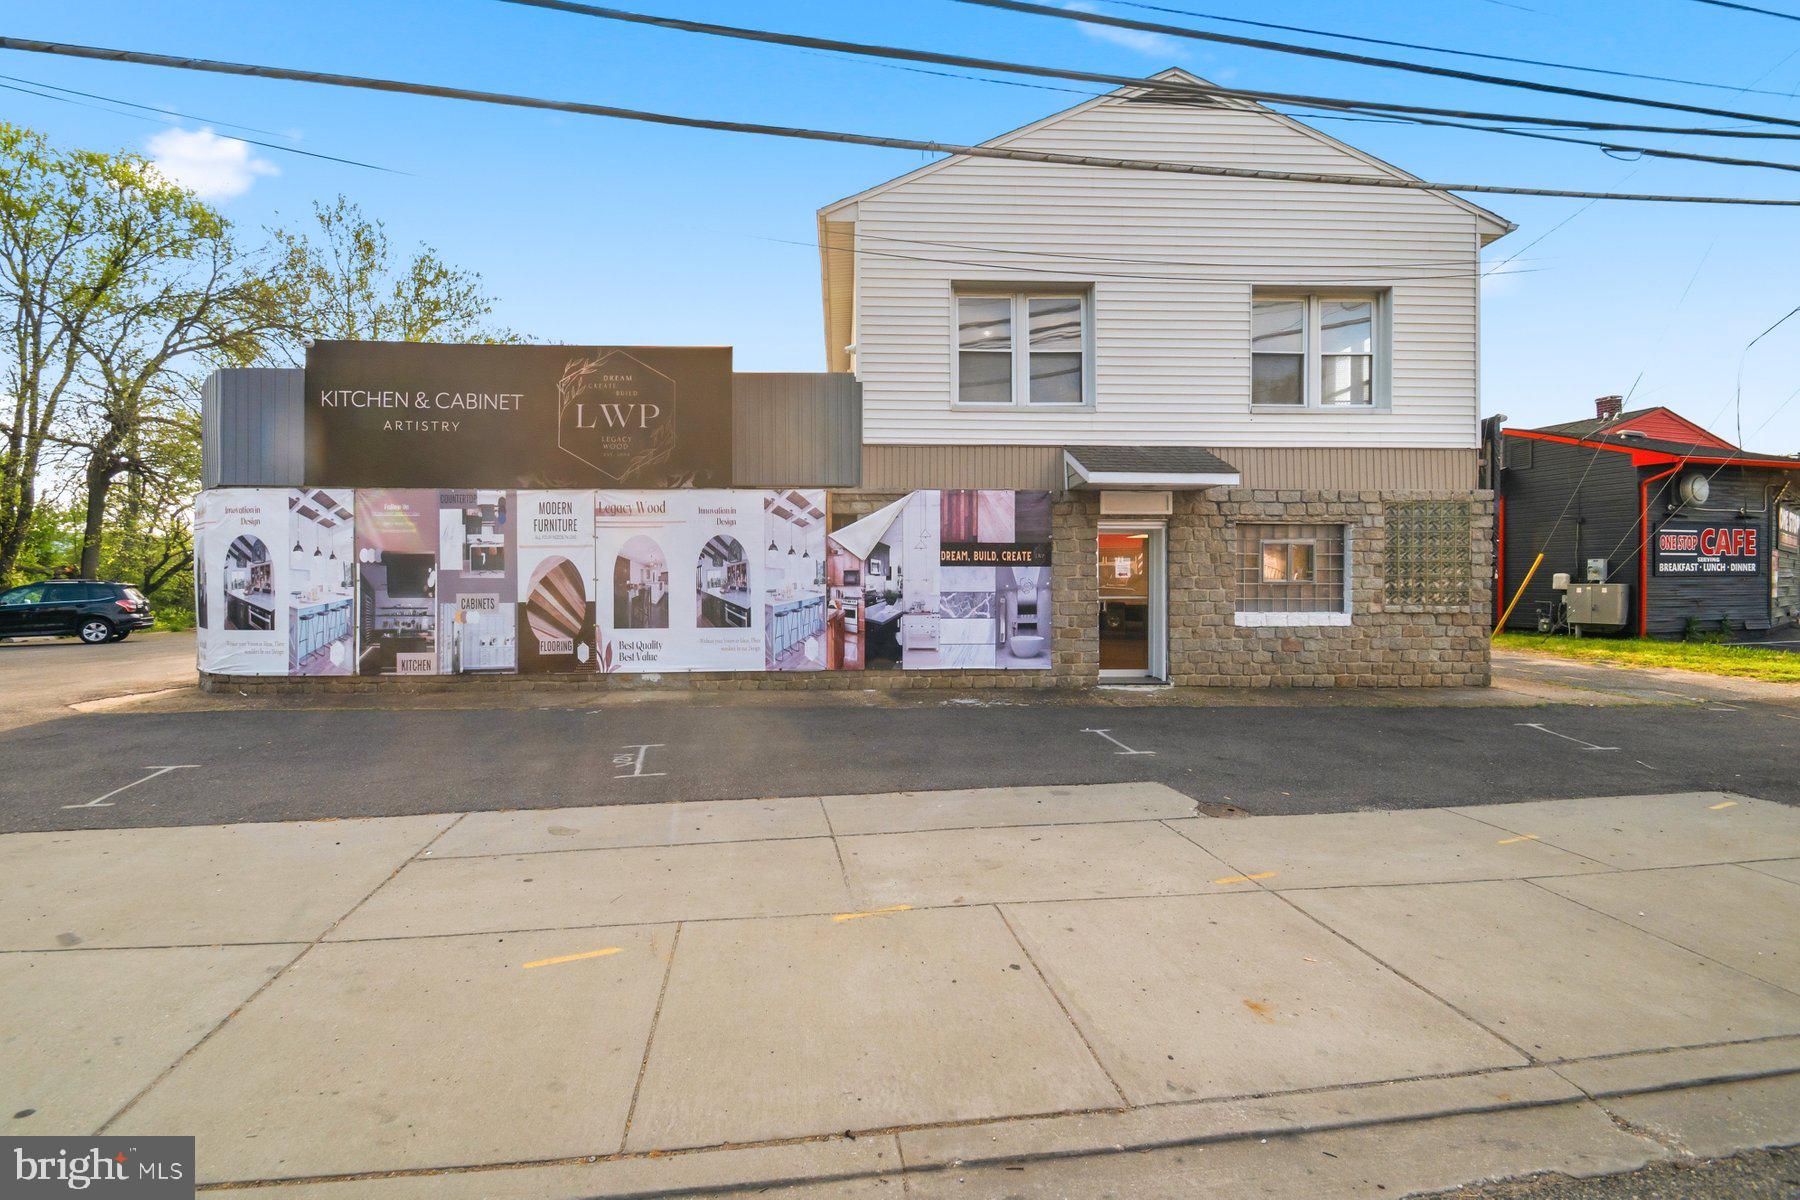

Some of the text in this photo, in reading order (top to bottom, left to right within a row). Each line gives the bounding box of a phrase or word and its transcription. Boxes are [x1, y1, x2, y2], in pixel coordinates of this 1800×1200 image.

[321, 390, 524, 410] KITCHEN & CABINET
[576, 403, 660, 428] LWP
[383, 420, 460, 432] ARTISTRY
[538, 501, 573, 515] MODERN
[599, 500, 666, 516] Legacy Wood
[533, 519, 578, 532] FURNITURE
[1660, 535, 1698, 551] ONE STOP
[1700, 528, 1757, 556] CAFE
[1001, 551, 1032, 561] CREATE
[1659, 563, 1756, 572] BREAKFAST LUNCH DINNER
[461, 598, 495, 610] CABINETS
[540, 641, 573, 652] FLOORING
[619, 640, 635, 650] Best
[619, 652, 635, 662] Best
[401, 660, 432, 672] KITCHEN
